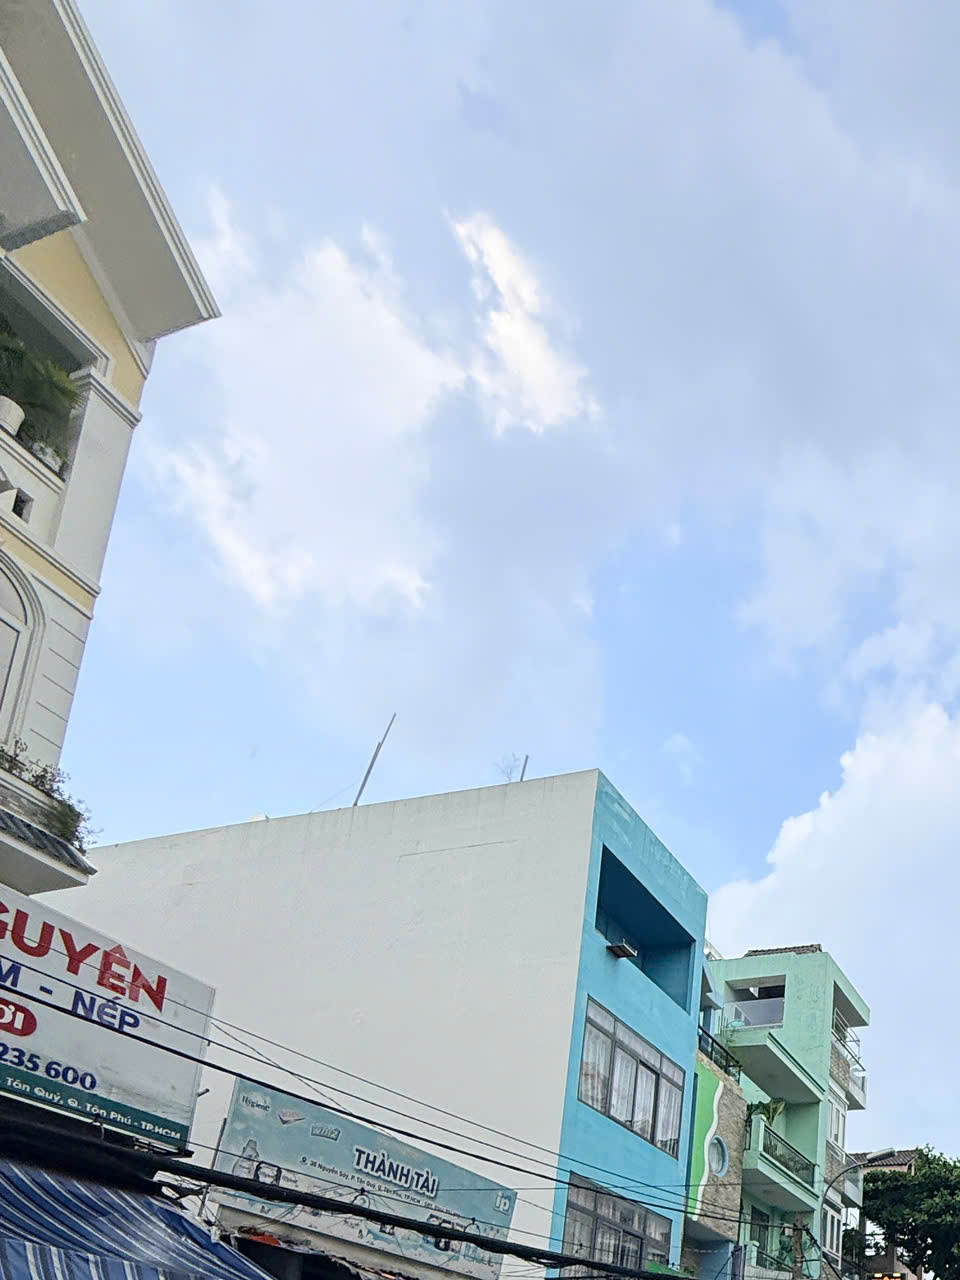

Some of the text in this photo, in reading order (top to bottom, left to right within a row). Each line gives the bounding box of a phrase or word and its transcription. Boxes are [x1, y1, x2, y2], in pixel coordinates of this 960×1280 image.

[71, 989, 140, 1033] NẾP
[45, 1061, 97, 1091] 600
[6, 1076, 30, 1093] Tân
[67, 1098, 82, 1111] Q.
[86, 1101, 107, 1119] Tân
[110, 1110, 132, 1127] Phú
[354, 1147, 438, 1195] THÀNH TÀI
